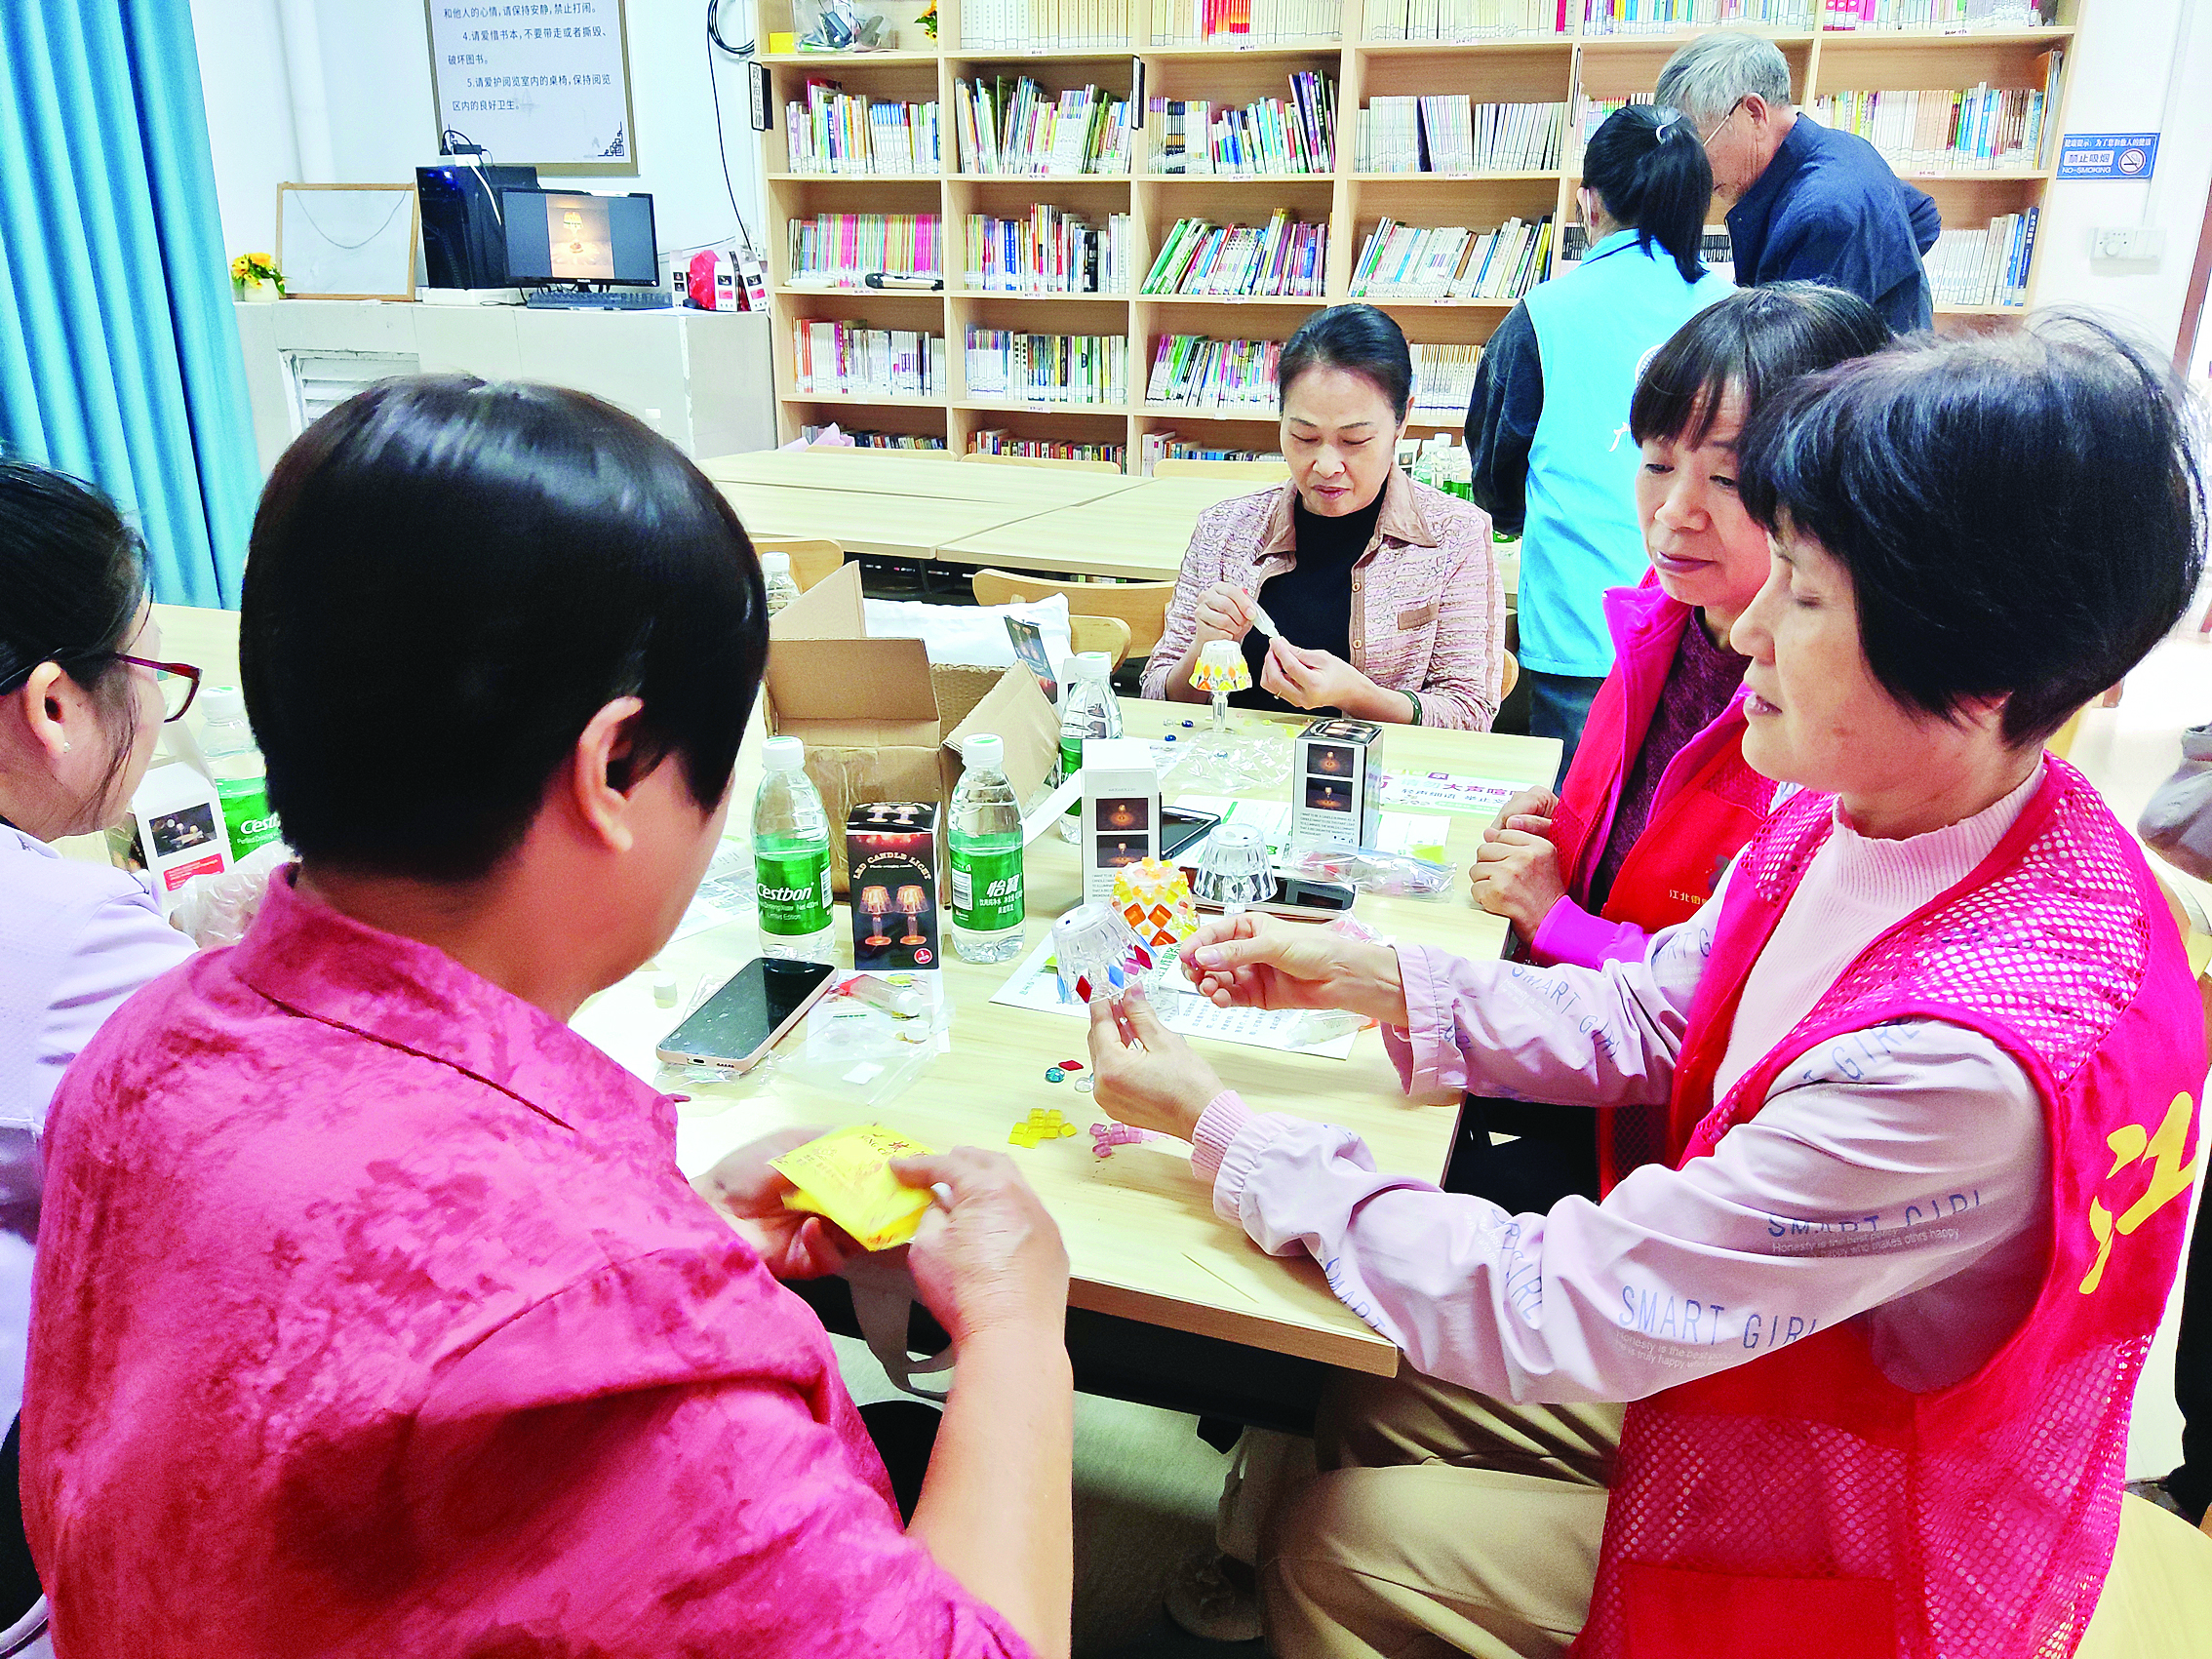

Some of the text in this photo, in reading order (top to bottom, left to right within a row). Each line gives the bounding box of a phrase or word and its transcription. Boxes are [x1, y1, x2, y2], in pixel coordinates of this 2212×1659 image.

[448, 54, 488, 65] 破坏图书。
[453, 99, 520, 112] 区内的良好卫生。
[2069, 153, 2110, 164] 禁止吸烟
[867, 851, 908, 864] CANDLE
[1872, 1237, 1903, 1251] makes
[1929, 1227, 1960, 1242] happy
[1618, 1284, 1725, 1346] SMART
[1637, 1350, 1657, 1364] truly
[1658, 1353, 1686, 1369] happy
